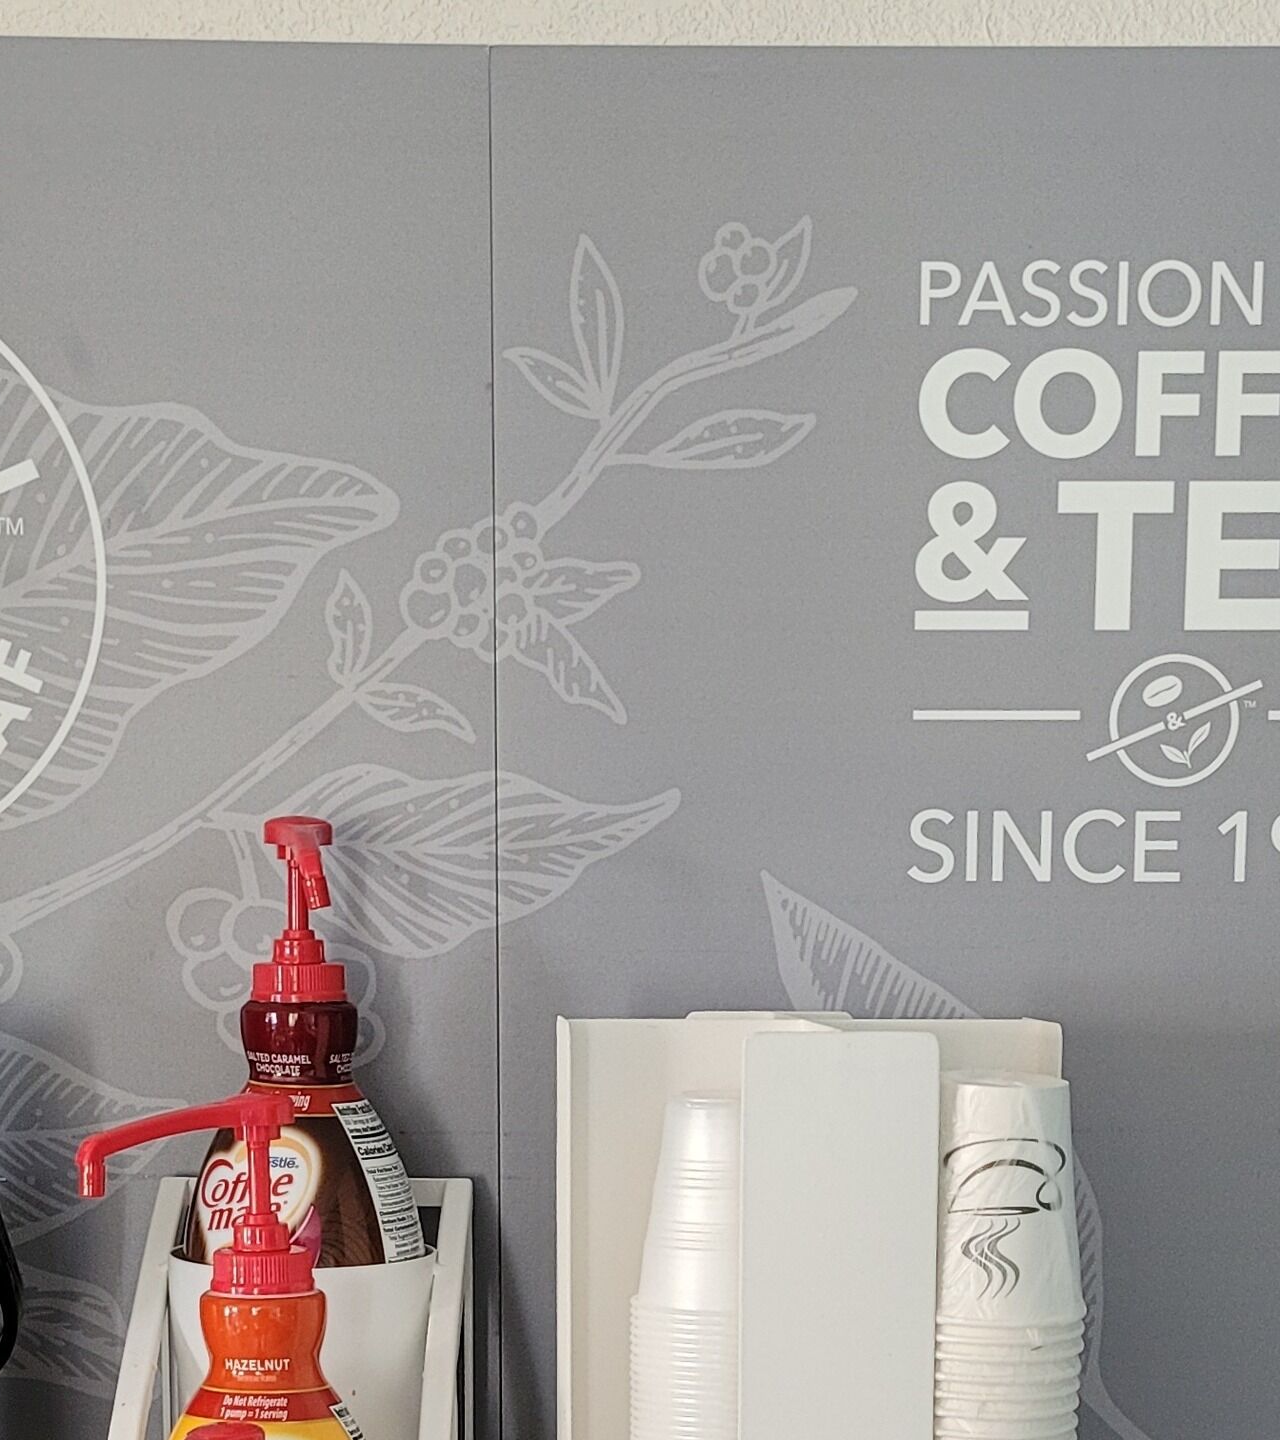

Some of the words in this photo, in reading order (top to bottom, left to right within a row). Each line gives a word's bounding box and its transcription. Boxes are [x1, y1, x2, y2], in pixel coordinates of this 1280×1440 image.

[919, 259, 1265, 327] PASSION
[915, 480, 1029, 603] &
[907, 809, 1182, 884] SINCE
[271, 1054, 311, 1065] CARAMEL
[256, 1063, 301, 1077] CHOCOLATE
[225, 1358, 290, 1371] HAZELNUT
[223, 1395, 233, 1406] Do
[233, 1396, 247, 1407] Not
[247, 1395, 288, 1410] Refrigerate
[220, 1407, 226, 1418] 1
[224, 1409, 247, 1421] pump
[254, 1408, 260, 1419] 1
[260, 1409, 289, 1422] serving
